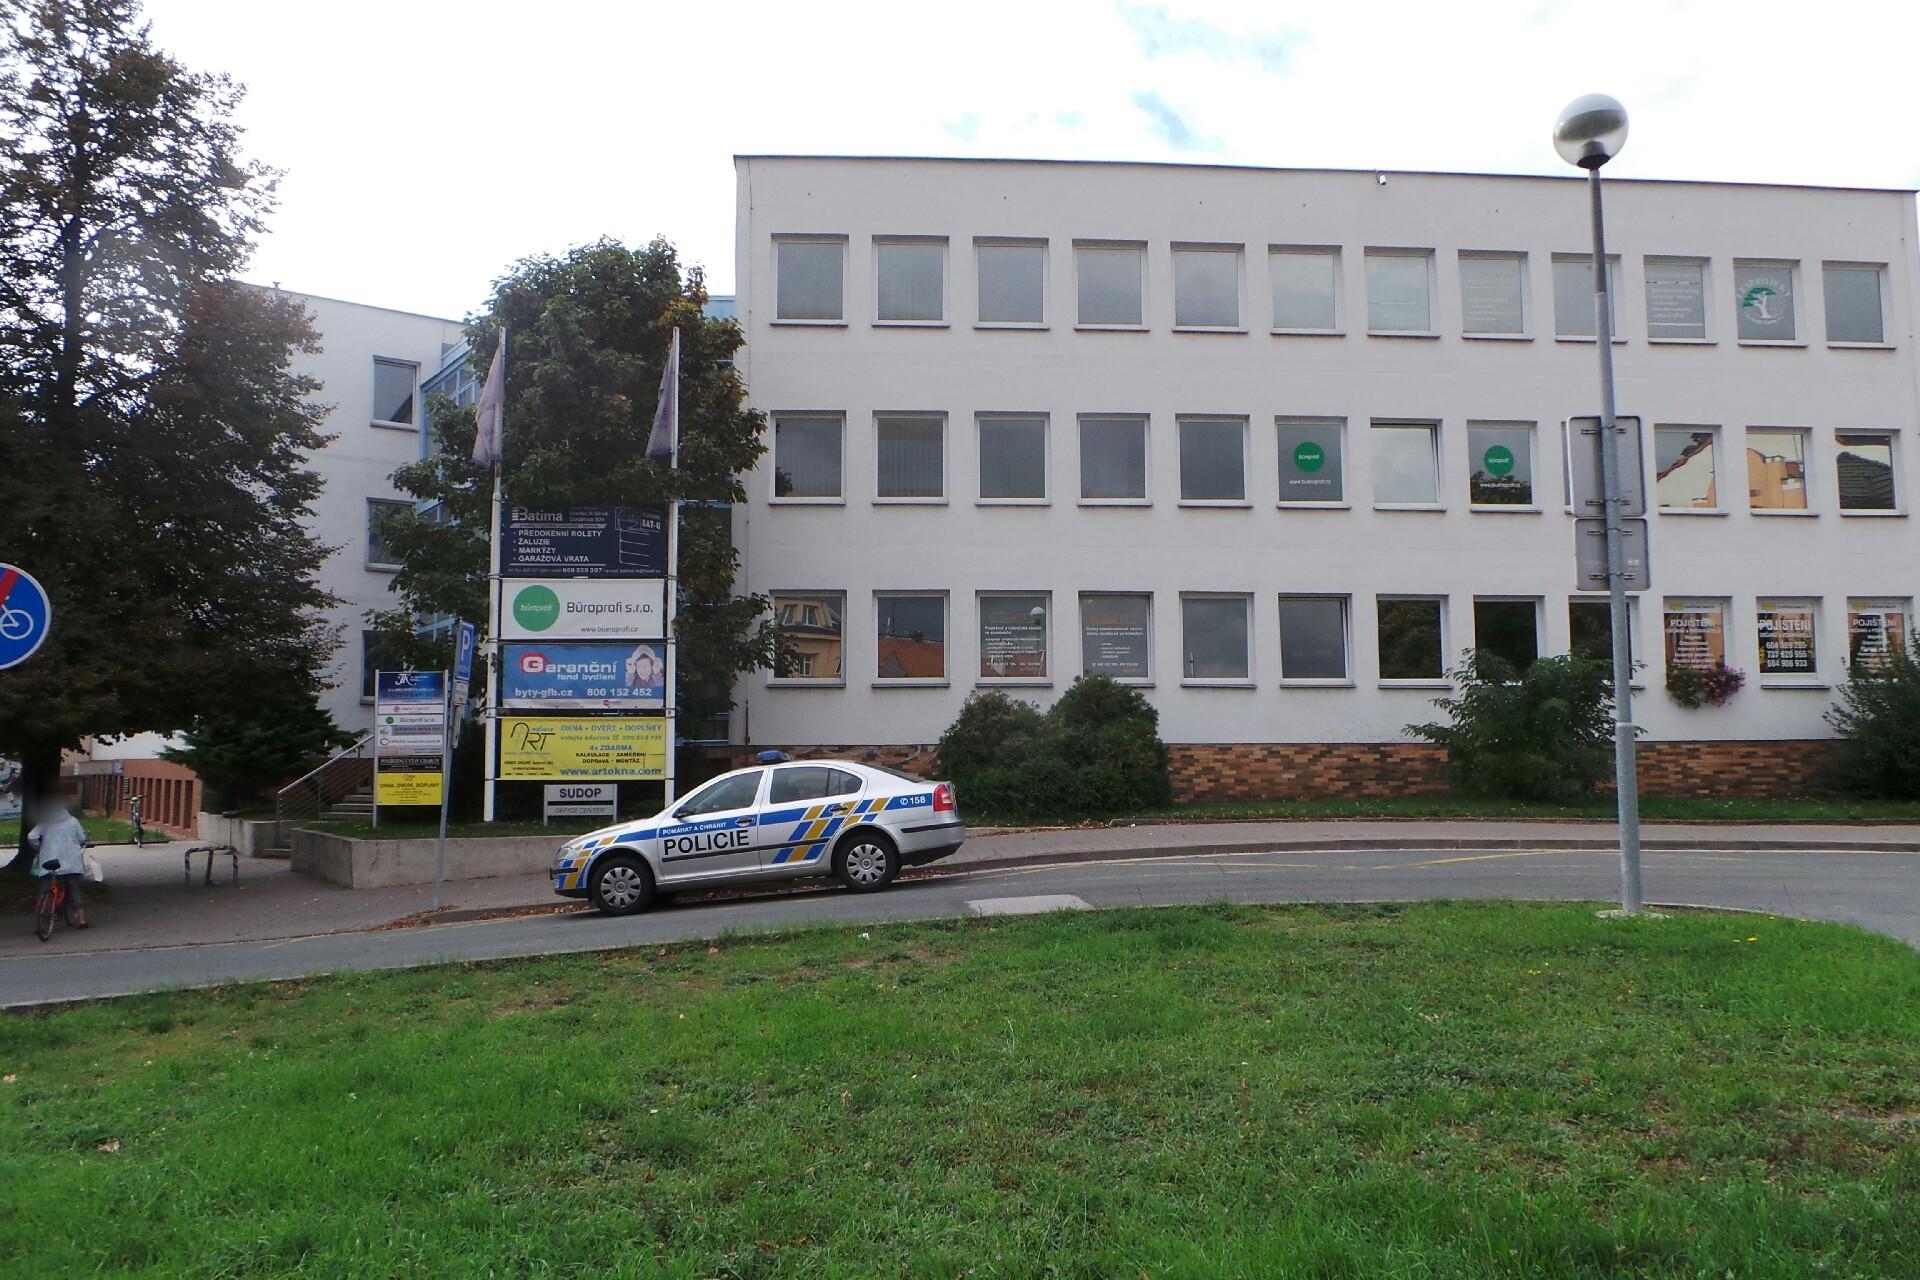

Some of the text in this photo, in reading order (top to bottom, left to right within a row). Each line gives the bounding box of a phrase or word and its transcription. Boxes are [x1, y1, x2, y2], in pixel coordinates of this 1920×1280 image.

[511, 506, 563, 522] Batima
[518, 529, 602, 537] PŘEDOKENNÍ ROLETY
[518, 537, 550, 545] ŽALUZIE
[518, 546, 555, 554] MARKÝZY
[518, 554, 562, 562] GARÁŽOVÁ
[567, 601, 654, 615] Büroprofi s.r.o.
[461, 630, 471, 661] P
[522, 656, 617, 673] Garanční
[514, 688, 652, 698] byty-gfb.cz 800 152 452
[560, 724, 583, 732] OKNA
[591, 724, 616, 732] DVEŘE
[624, 724, 662, 732] DOPLŇKY
[560, 767, 662, 776] www.artokna.com
[559, 788, 602, 798] SUDOP
[910, 796, 926, 804] 158
[662, 826, 692, 835] POMÁHAT
[700, 822, 726, 831] CHRÁNIT
[663, 830, 750, 856] POLICIE
